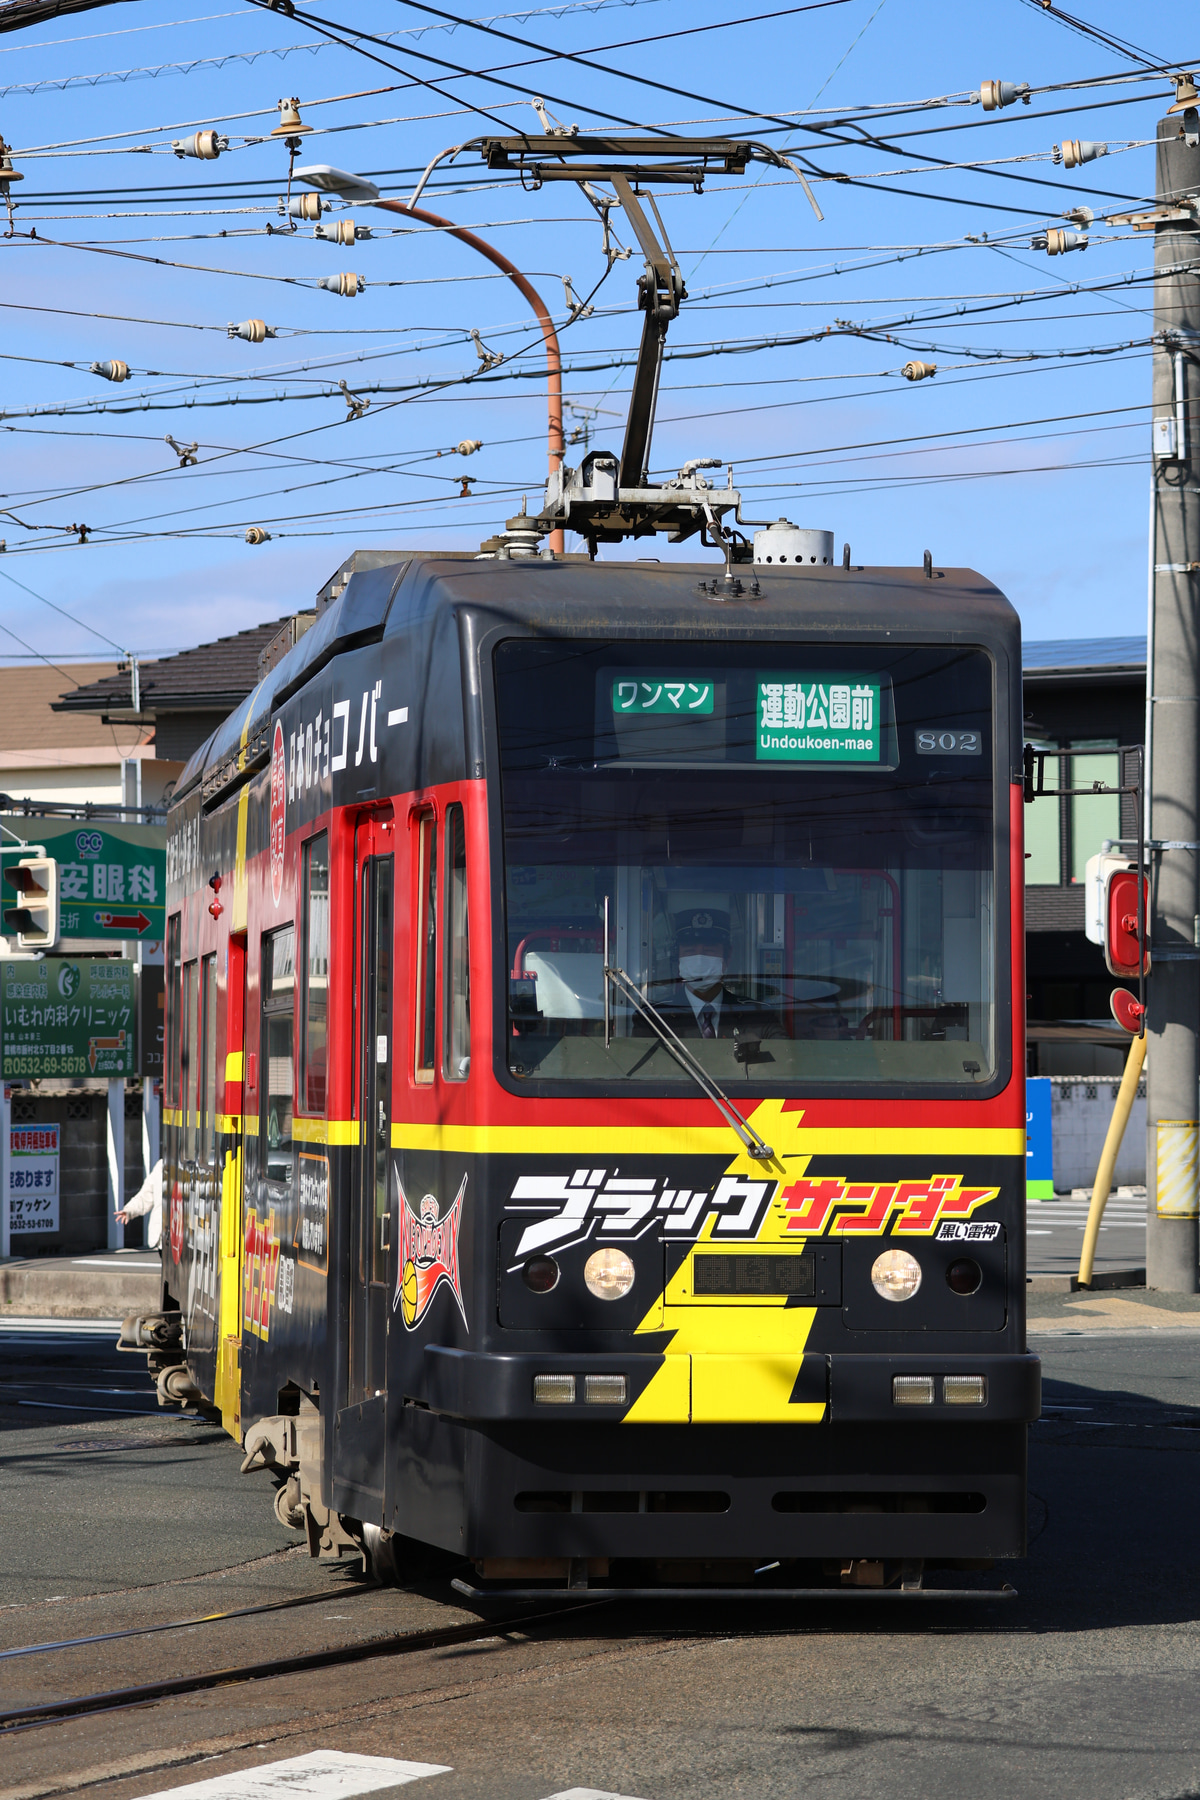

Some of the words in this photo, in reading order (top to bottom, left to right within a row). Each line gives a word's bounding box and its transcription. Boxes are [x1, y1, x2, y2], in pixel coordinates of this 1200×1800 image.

[618, 682, 710, 709] ワンマン
[760, 683, 875, 731] 運動公園前
[288, 680, 409, 806] 日本のチョコバー
[760, 734, 874, 750] Undoukoen-mae
[918, 732, 978, 751] 802
[89, 964, 130, 981] 呼吸器内科
[6, 982, 48, 999] 感染症内科
[5, 1004, 131, 1027] いむれ内科クリニック
[13, 1056, 86, 1074] 0532-69-5678
[938, 1221, 1001, 1241] 黒い雷神
